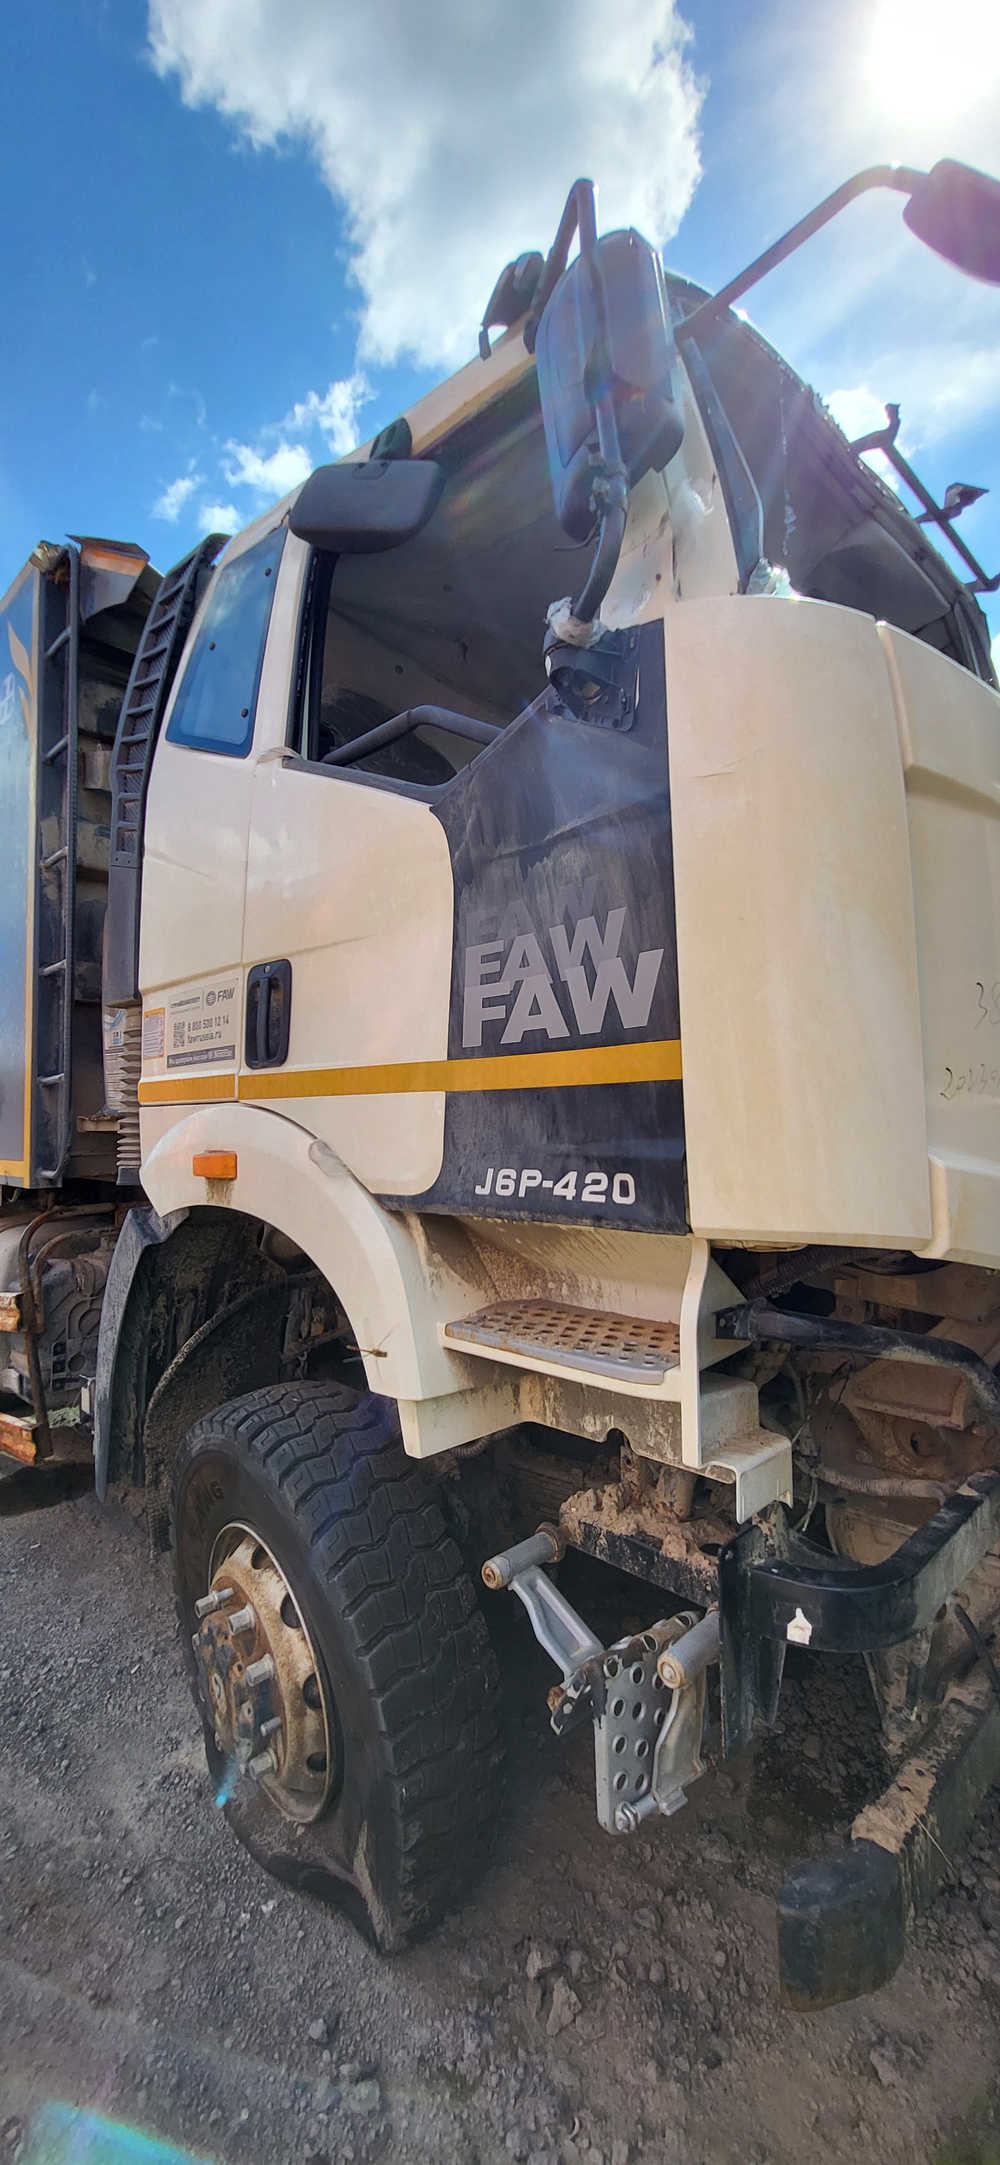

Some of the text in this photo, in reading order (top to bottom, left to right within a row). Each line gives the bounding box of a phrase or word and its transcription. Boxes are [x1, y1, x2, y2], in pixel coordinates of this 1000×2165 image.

[464, 905, 628, 998] FAW
[217, 987, 235, 1002] FAW
[461, 948, 665, 1048] FAW
[192, 1020, 202, 1032] 800
[203, 1017, 213, 1029] 500
[214, 1016, 221, 1027] 12
[222, 1014, 229, 1025] 14
[187, 1030, 222, 1044] fawrussia.ru
[475, 1168, 636, 1205] J6P-420
